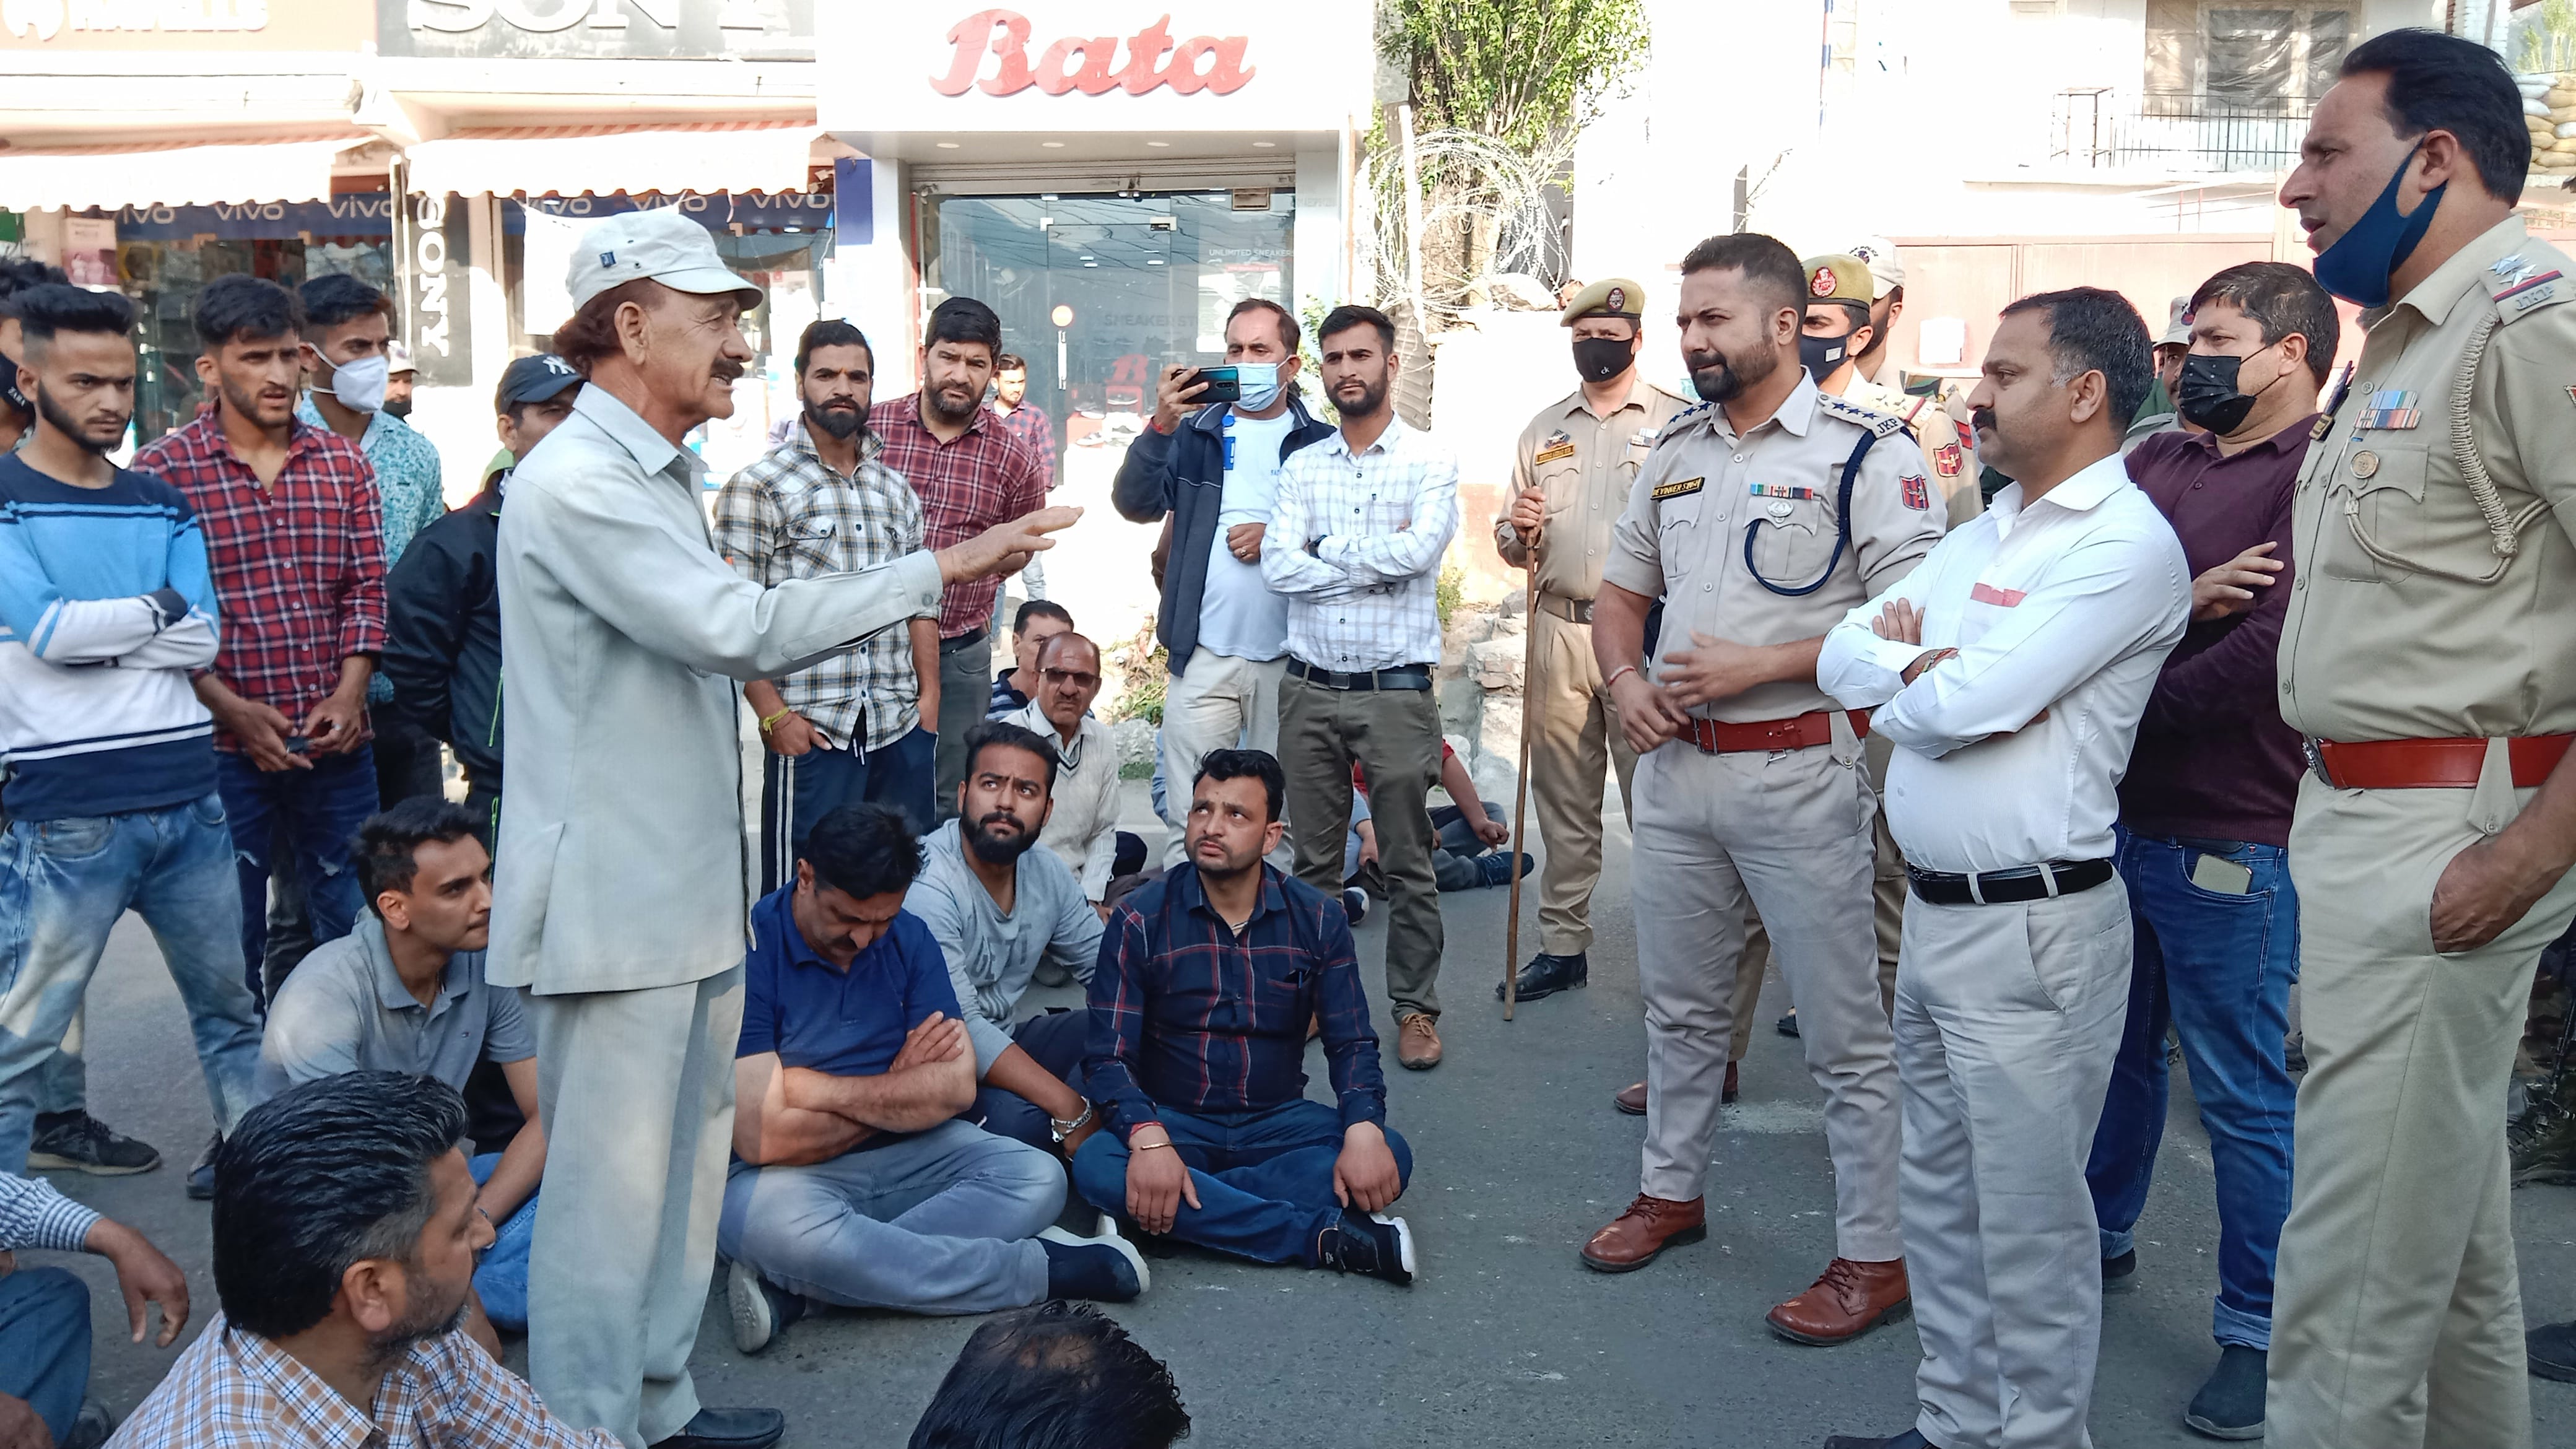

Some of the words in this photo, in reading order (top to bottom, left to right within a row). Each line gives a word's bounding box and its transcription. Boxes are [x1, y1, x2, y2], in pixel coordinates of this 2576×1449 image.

[929, 9, 1256, 97] Bata
[417, 196, 450, 357] SONY
[1877, 418, 1898, 433] JKP
